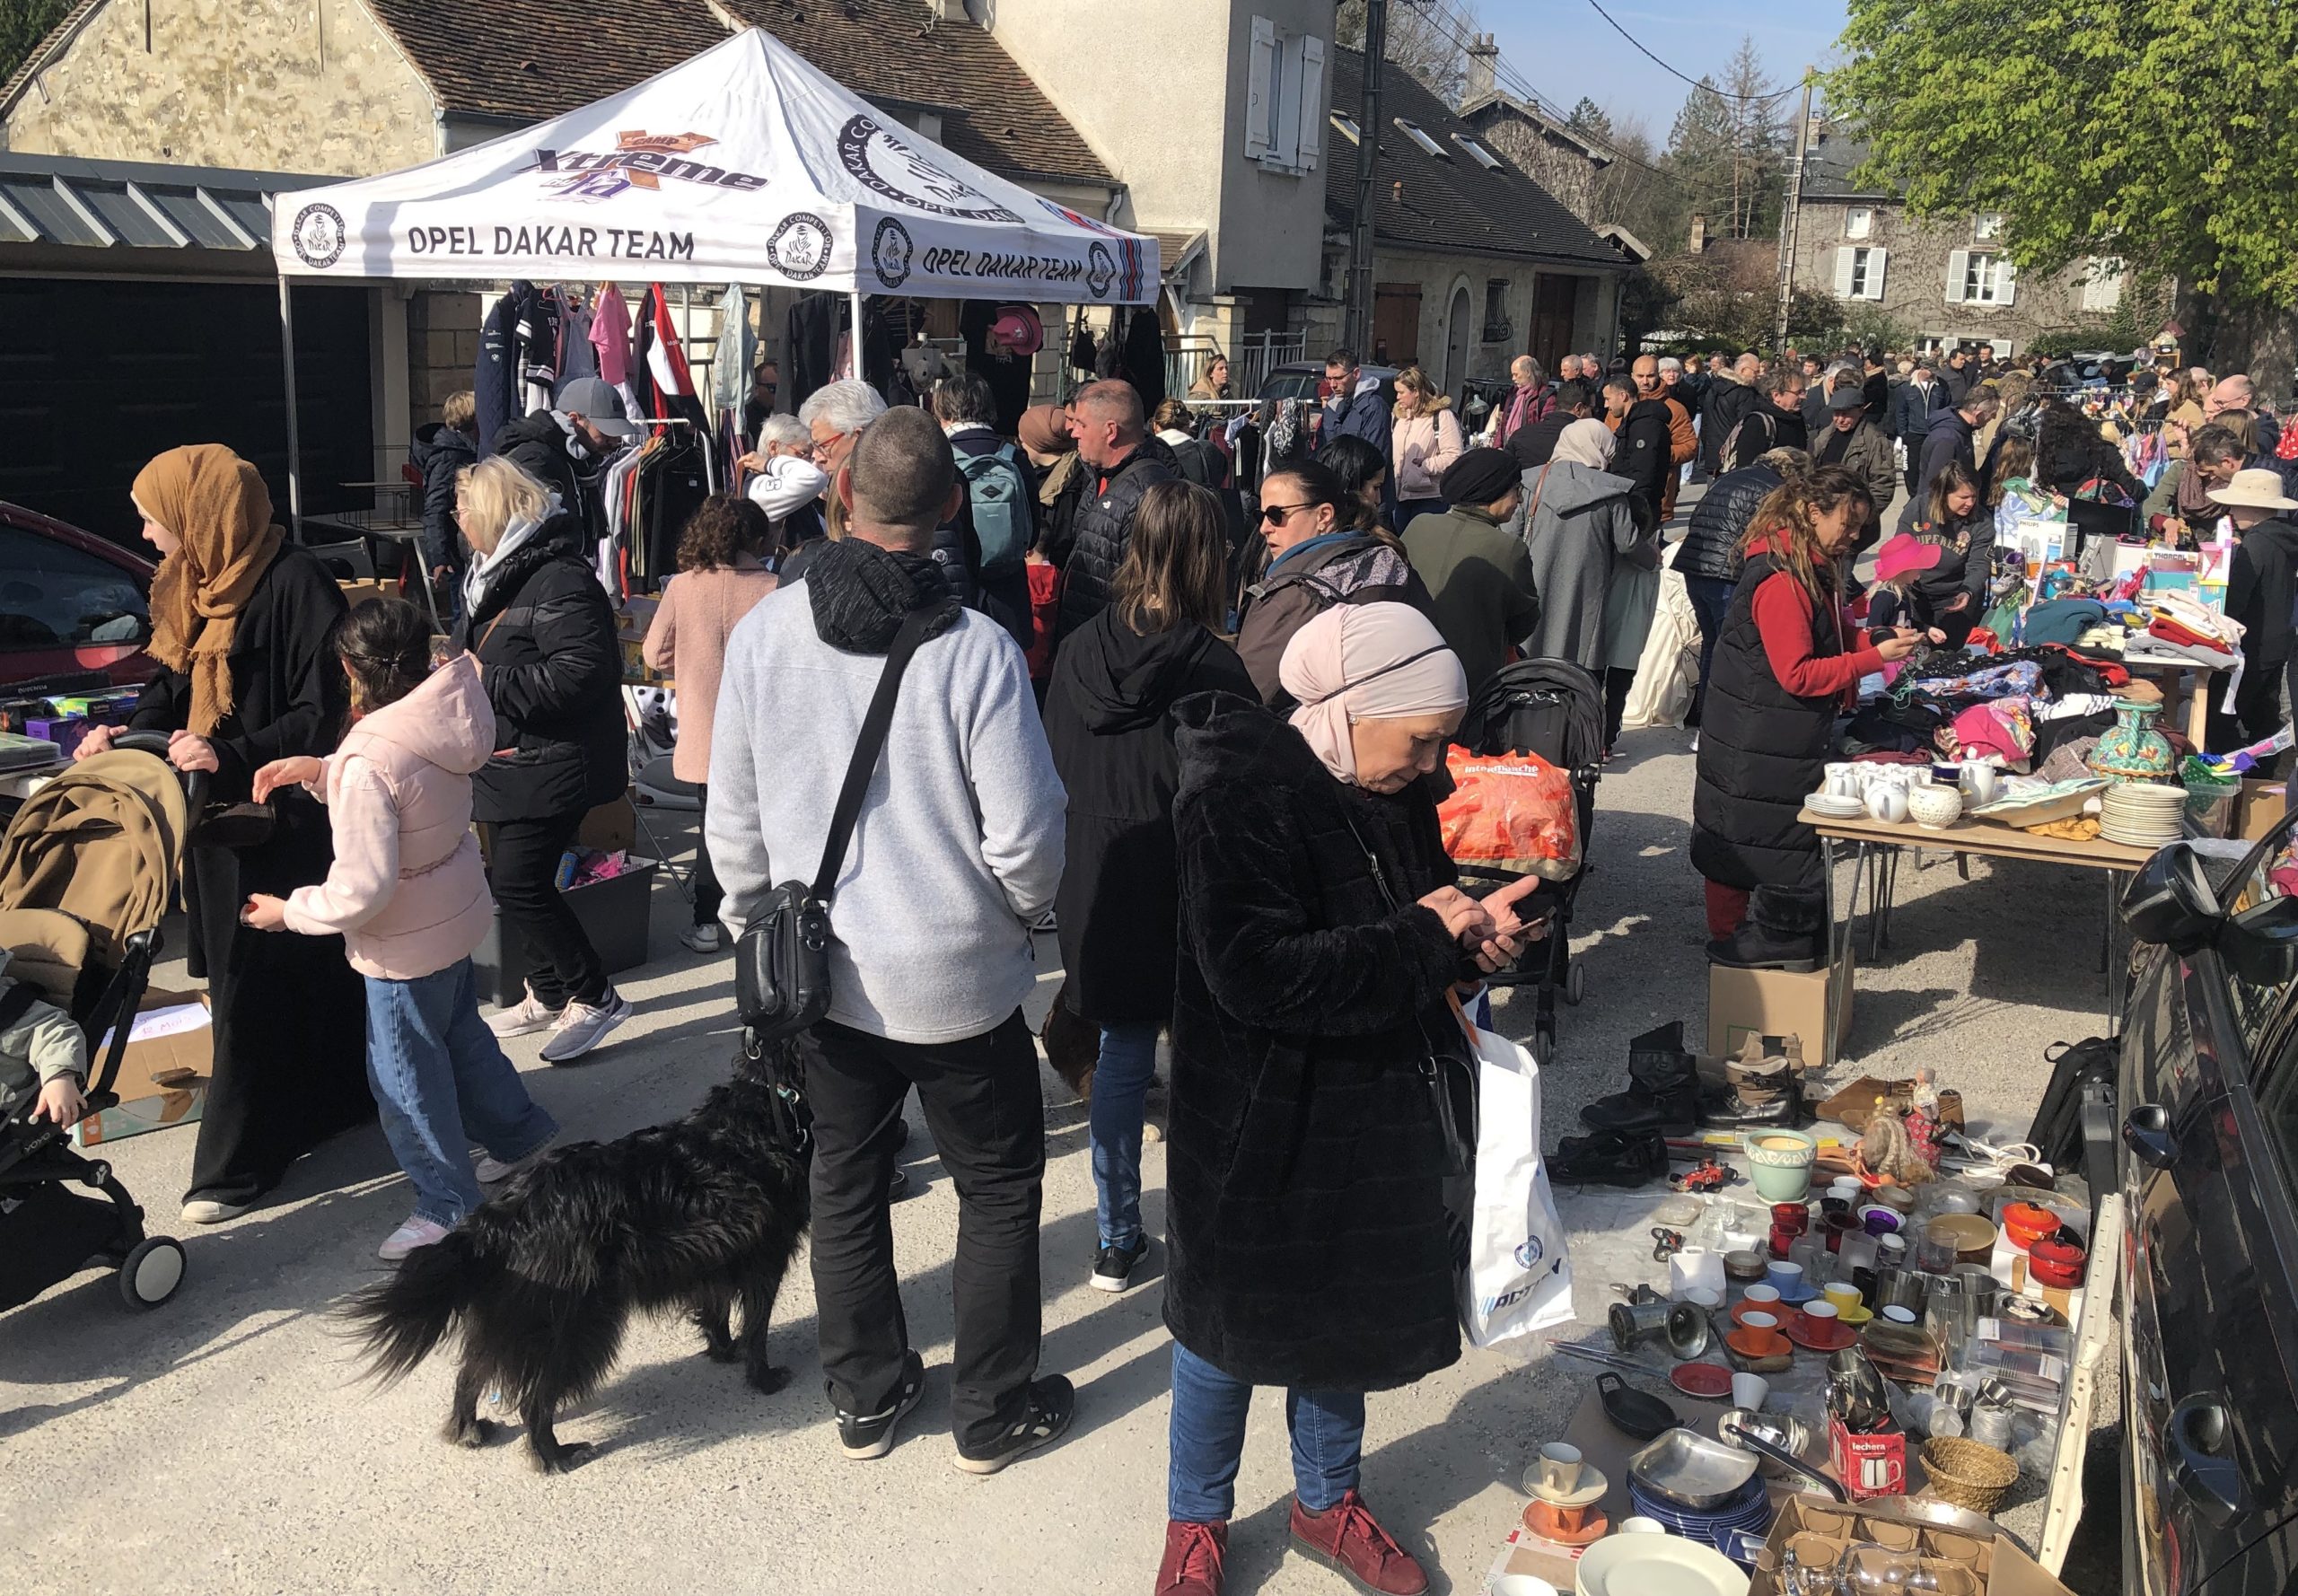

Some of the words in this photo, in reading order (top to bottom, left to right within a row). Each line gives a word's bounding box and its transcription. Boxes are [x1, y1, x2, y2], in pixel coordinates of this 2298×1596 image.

[632, 136, 680, 146] CAMP
[844, 142, 881, 191] DAKAR
[902, 196, 963, 217] OPEL
[294, 210, 308, 235] DAKAR
[309, 205, 345, 237] COMPETITOR
[767, 222, 789, 247] DAKAR
[789, 215, 832, 249] COMPETITOR
[408, 226, 484, 254] OPEL
[494, 225, 598, 257] DAKAR
[607, 228, 695, 260] TEAM
[768, 253, 785, 274] OPEL
[786, 270, 814, 280] DAKAR
[812, 255, 829, 274] TEAM
[785, 250, 814, 266] DAKAR
[923, 247, 972, 276] OPEL
[975, 251, 1039, 279] DAKAR
[1039, 257, 1083, 282] TEAM
[23, 1132, 51, 1152] YOYO
[1852, 1442, 1887, 1451] lechera
